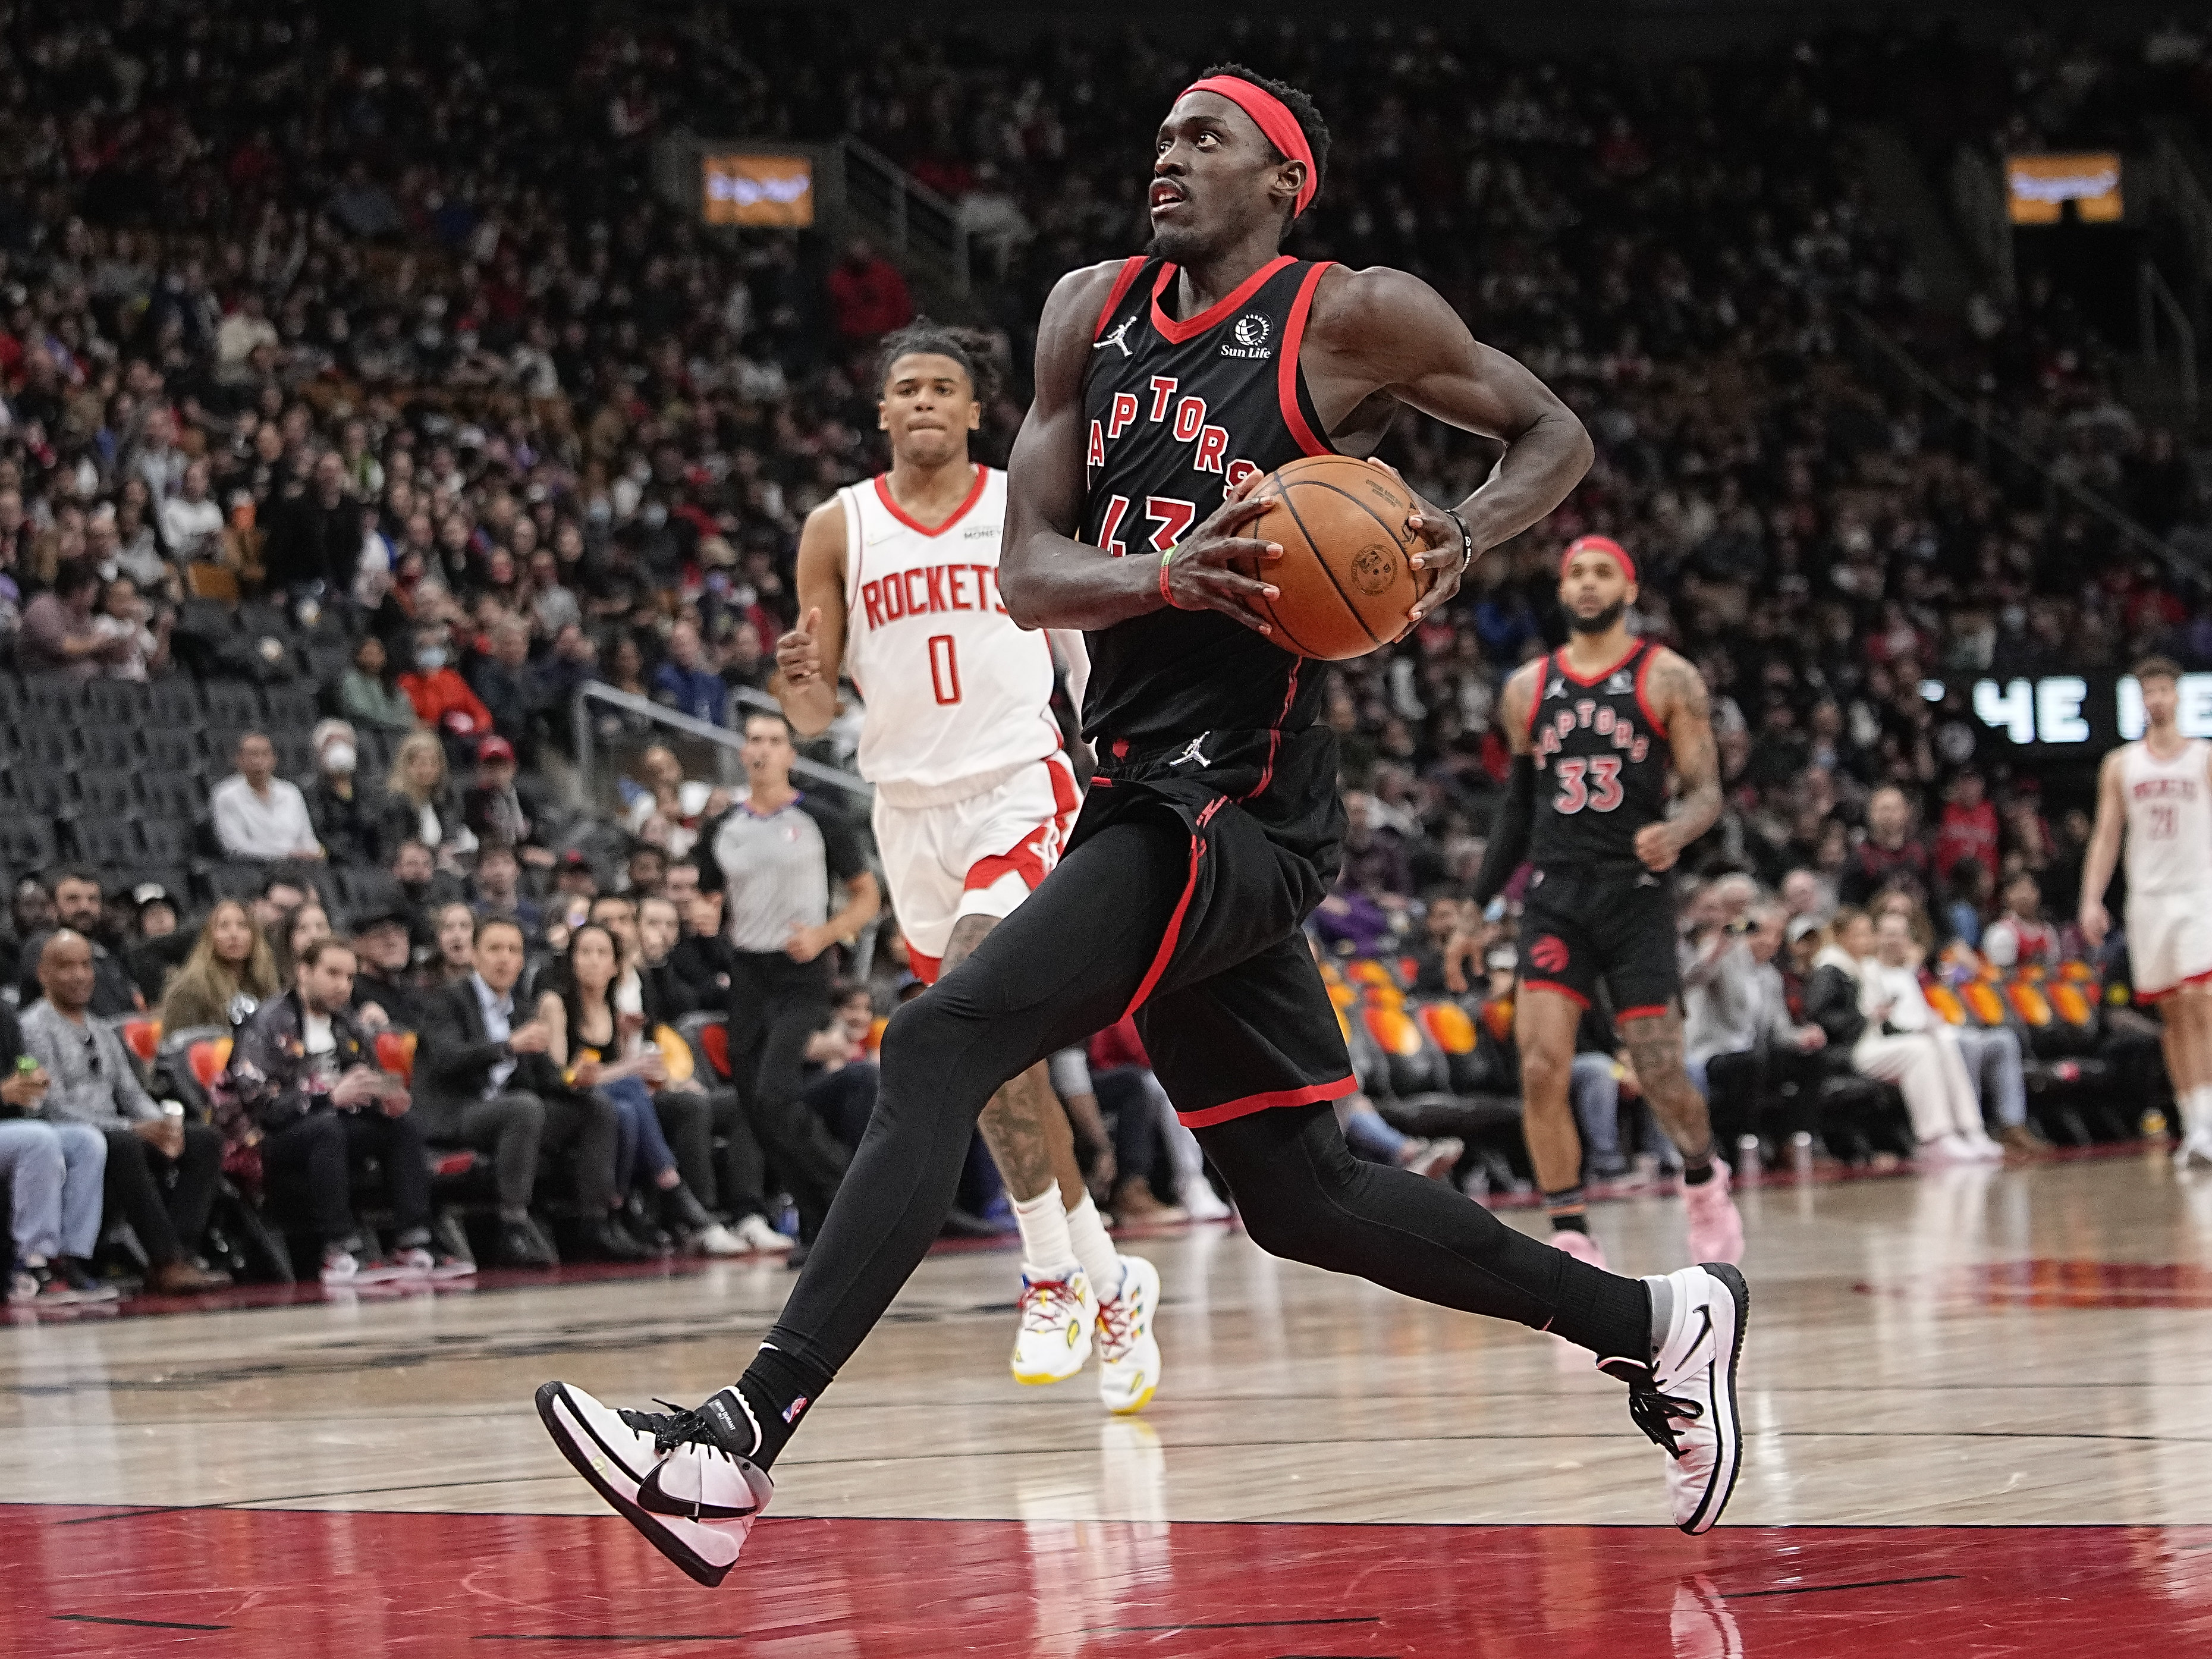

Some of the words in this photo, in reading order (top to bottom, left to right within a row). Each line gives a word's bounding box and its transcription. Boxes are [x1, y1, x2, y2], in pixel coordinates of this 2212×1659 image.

[1221, 344, 1246, 357] Sun
[1248, 347, 1271, 359] Life
[1087, 375, 1258, 501] APTORS
[928, 634, 962, 705] 0
[1553, 756, 1625, 815] 33
